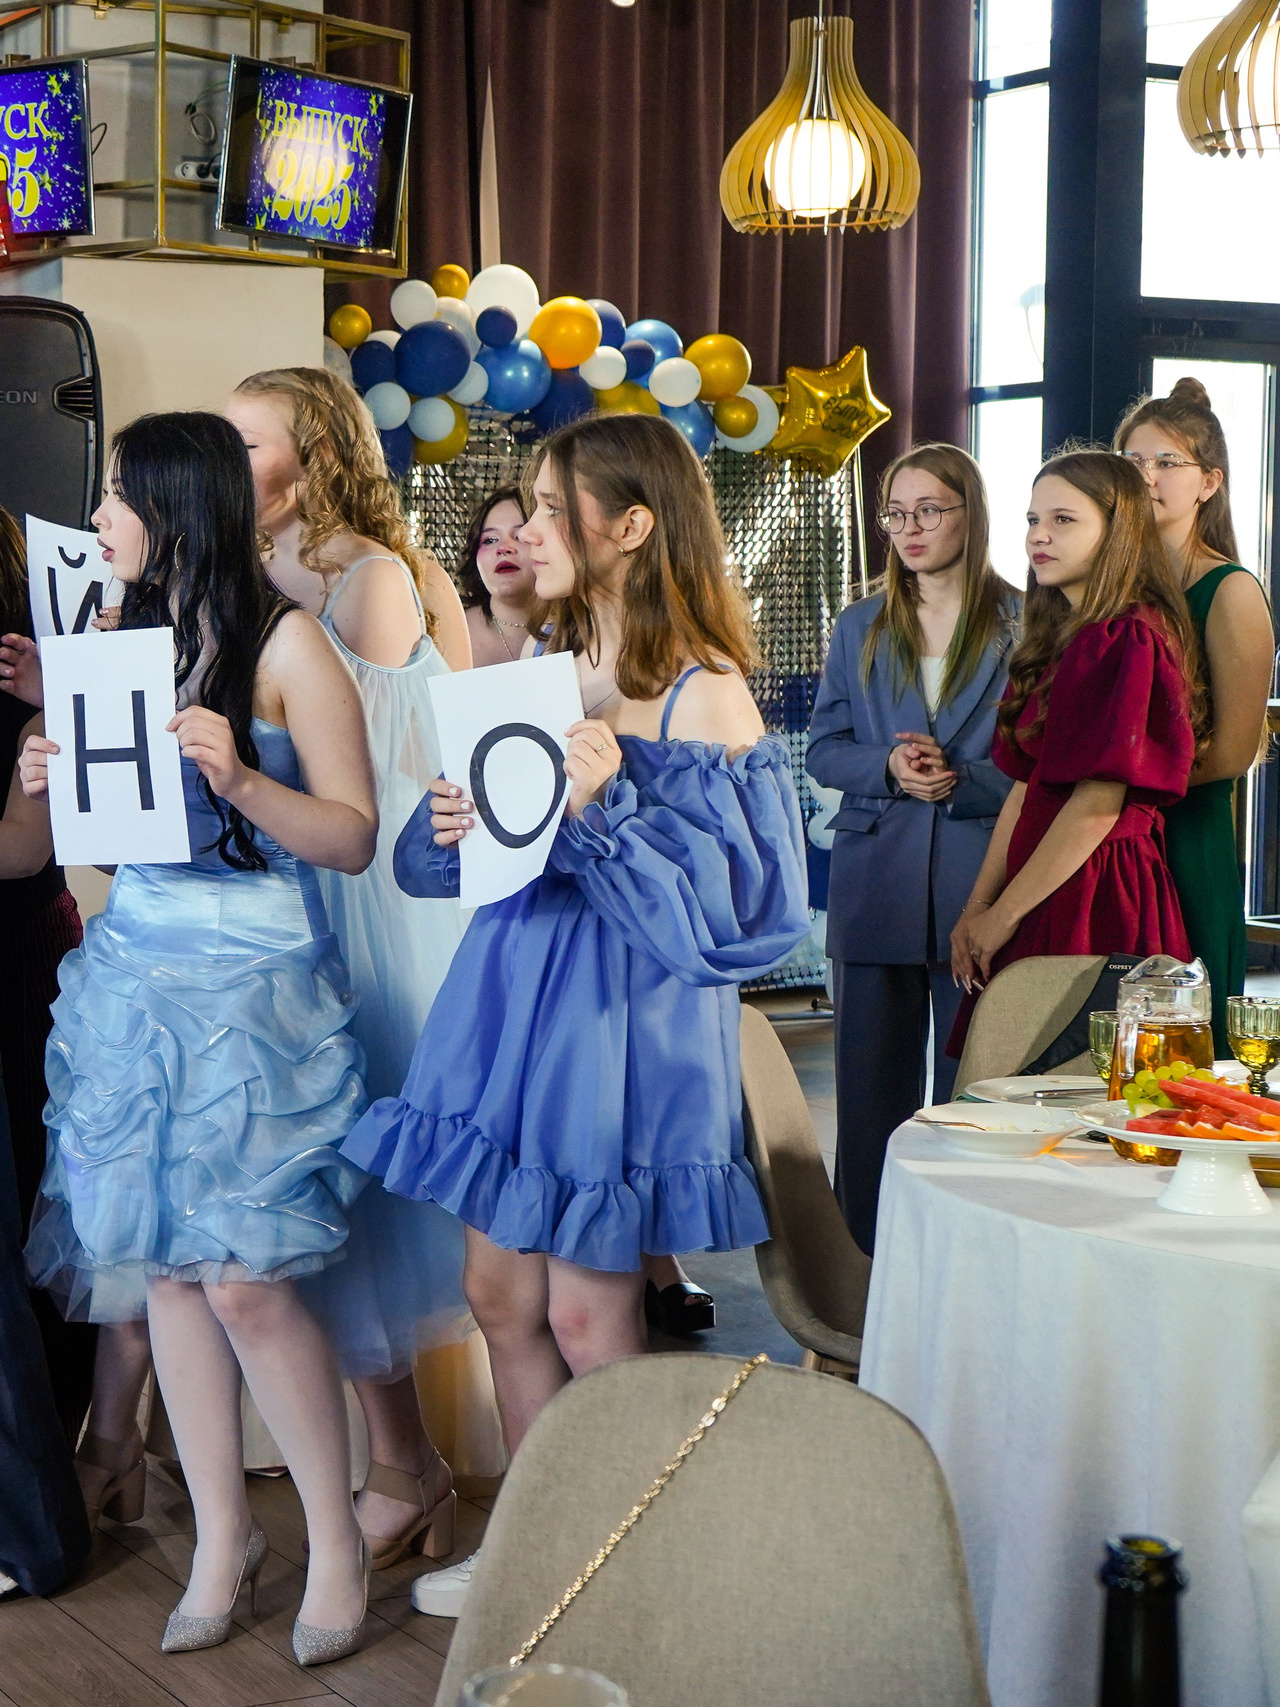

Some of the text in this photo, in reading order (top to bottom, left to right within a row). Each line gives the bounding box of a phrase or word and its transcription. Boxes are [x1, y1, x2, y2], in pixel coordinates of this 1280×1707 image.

[272, 99, 368, 153] ВЫПУСК
[271, 148, 355, 230] 2025
[72, 689, 156, 813] Н
[469, 722, 567, 849] О
